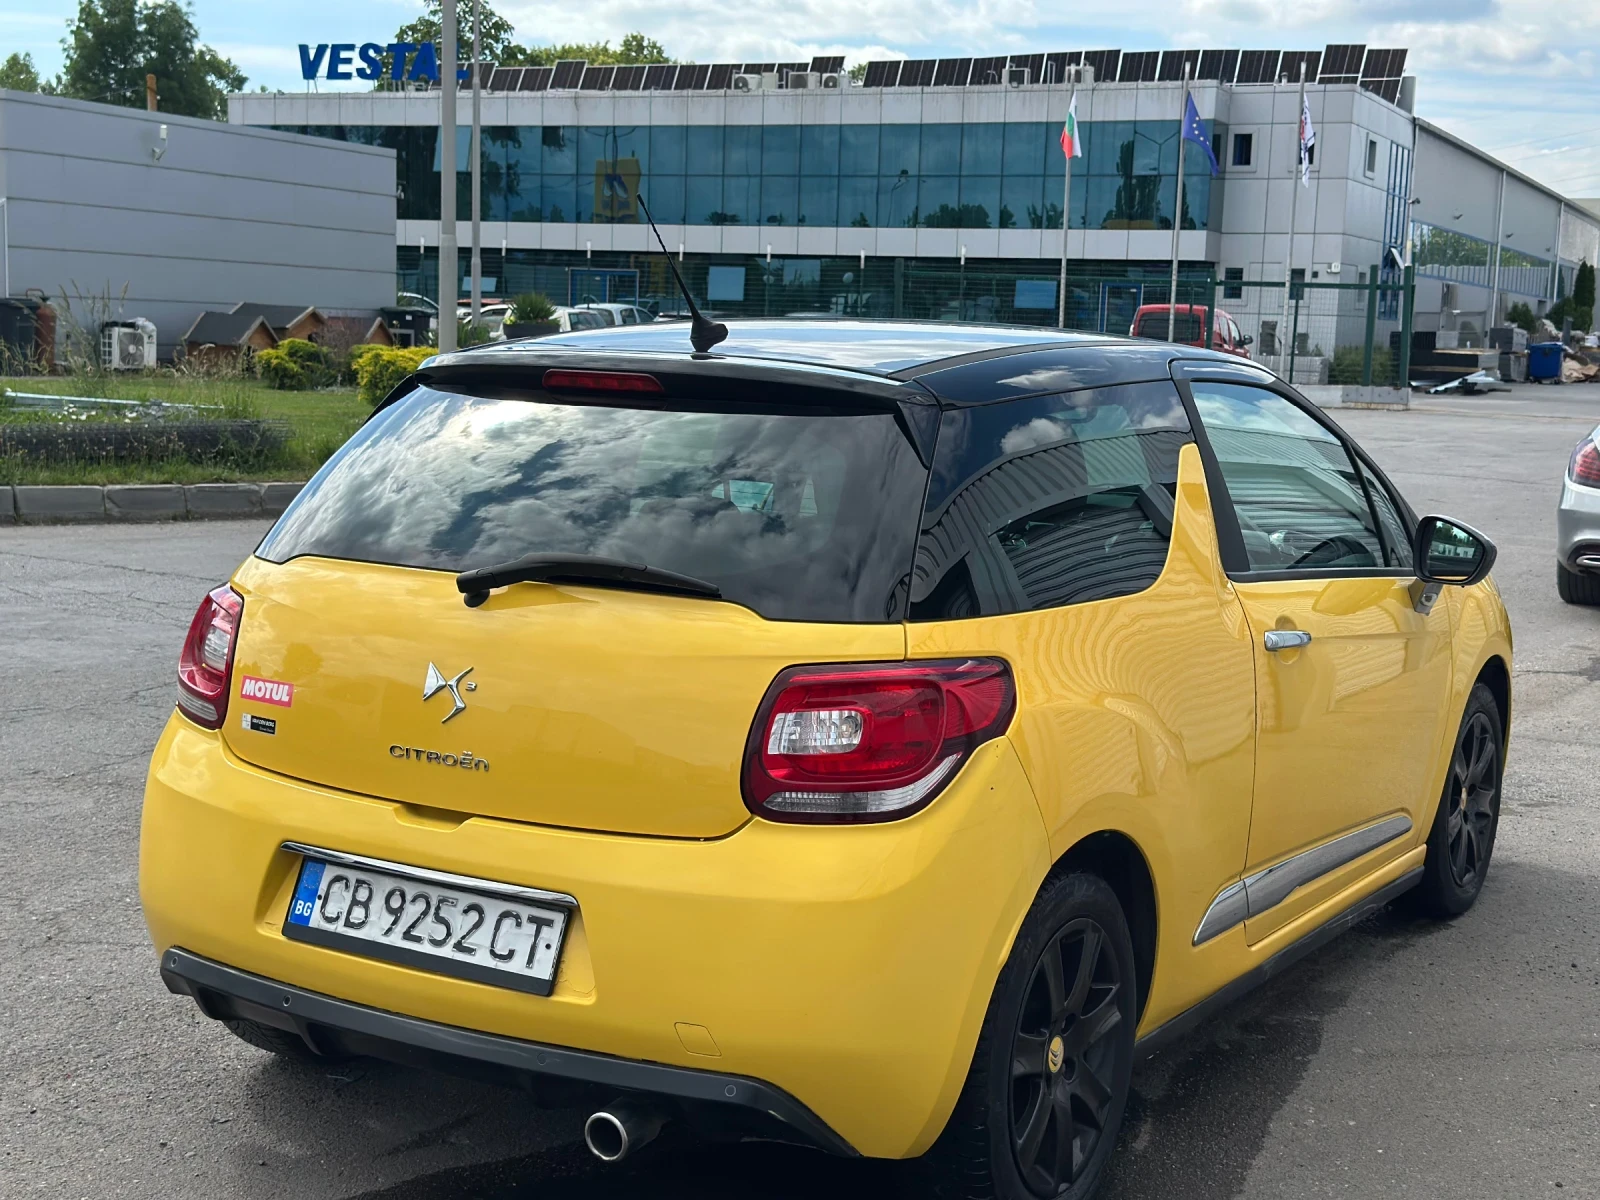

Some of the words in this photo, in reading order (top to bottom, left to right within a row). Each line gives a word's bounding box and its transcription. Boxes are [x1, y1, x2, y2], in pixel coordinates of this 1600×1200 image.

[298, 42, 469, 81] VESTA
[242, 678, 290, 702] MOTUL
[294, 899, 312, 917] BG
[319, 874, 374, 930] CB
[382, 886, 485, 955] 9252
[489, 909, 555, 969] CT
